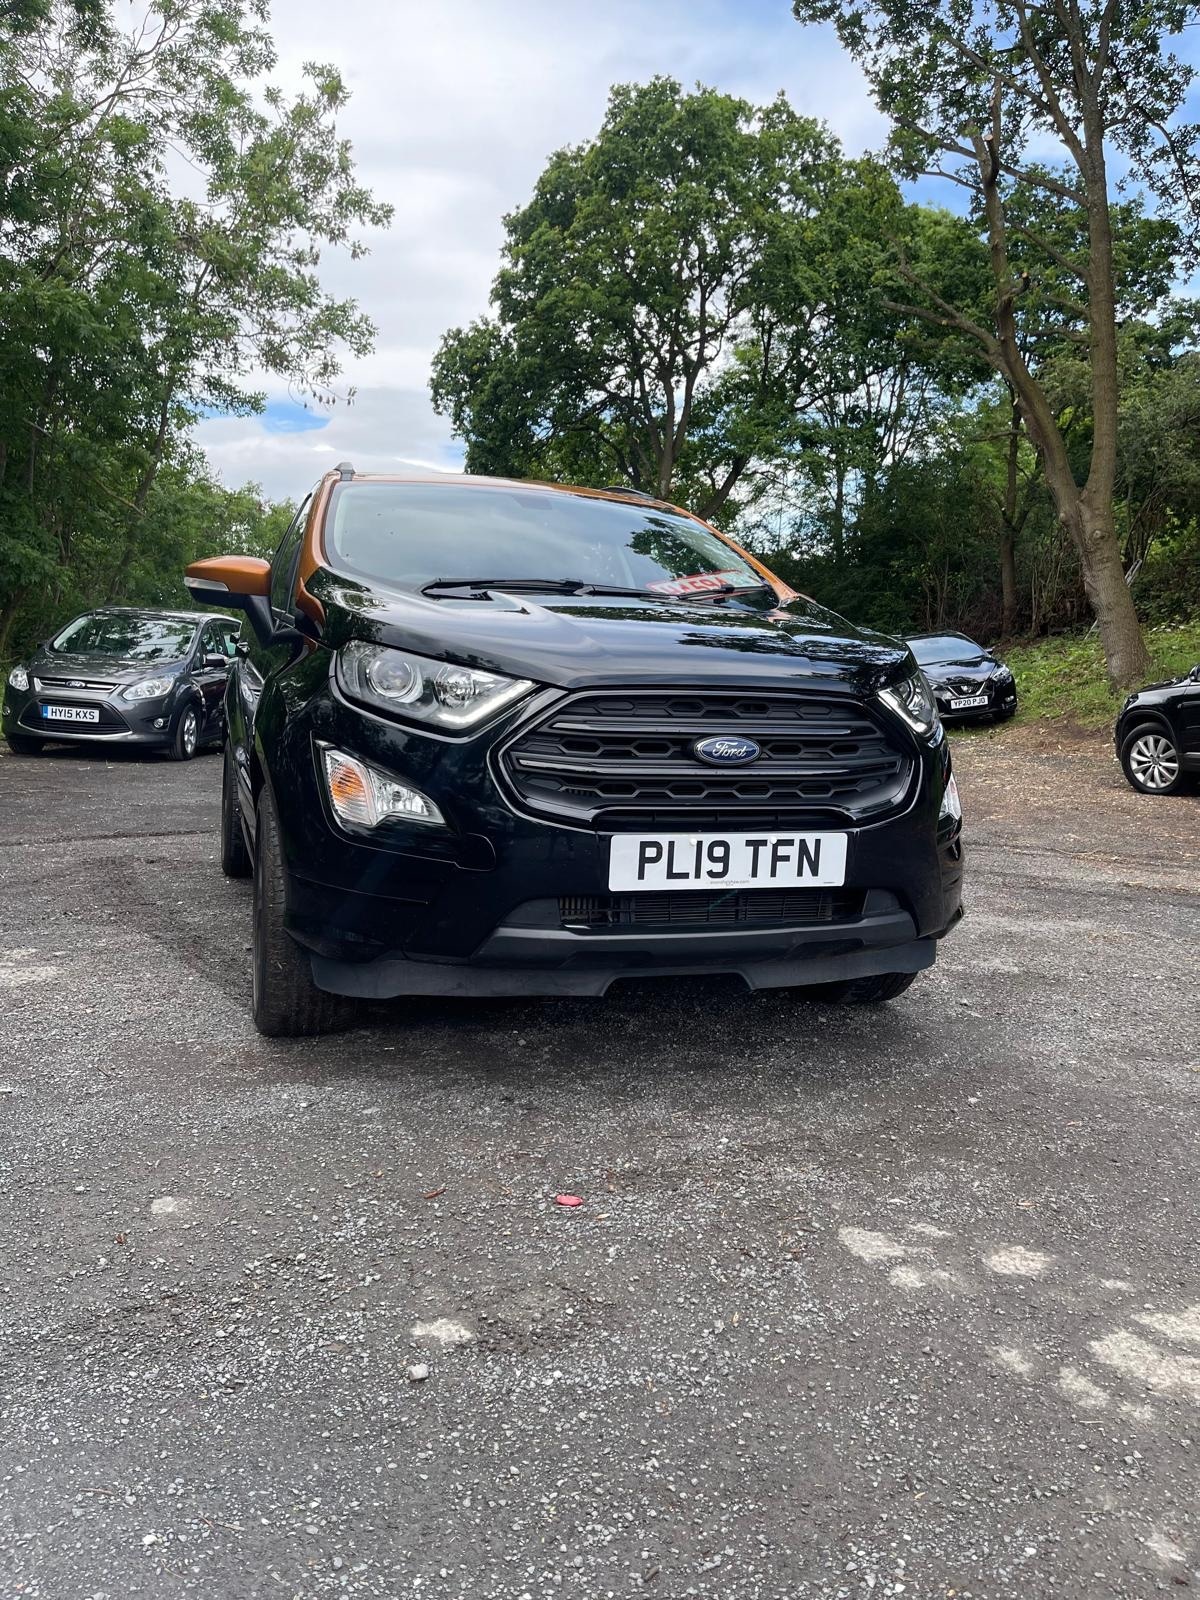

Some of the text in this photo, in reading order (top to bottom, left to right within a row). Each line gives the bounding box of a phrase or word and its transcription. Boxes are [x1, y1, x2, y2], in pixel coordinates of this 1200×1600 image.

[953, 699, 971, 707] YP20
[51, 707, 95, 720] HY15 KXS
[712, 741, 747, 757] Ford
[637, 838, 822, 880] PL19 TFN
